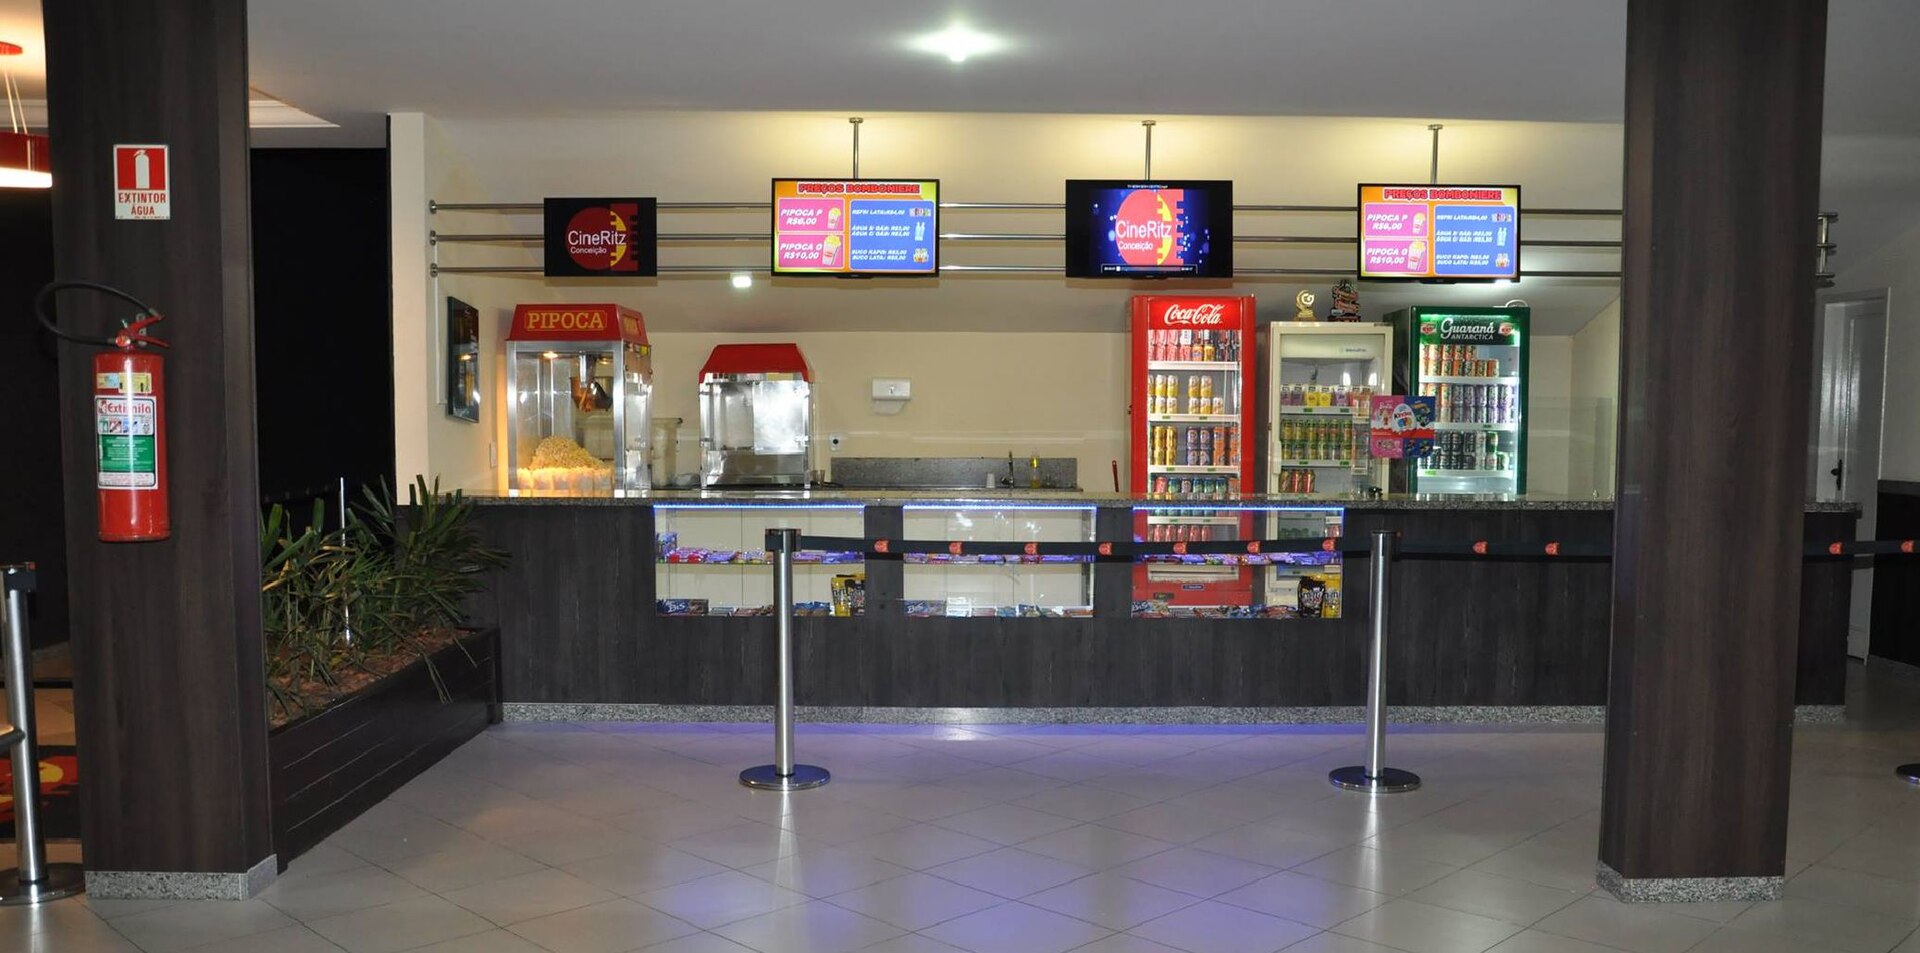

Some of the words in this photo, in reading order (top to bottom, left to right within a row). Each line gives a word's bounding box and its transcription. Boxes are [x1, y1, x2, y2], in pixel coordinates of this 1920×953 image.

[798, 184, 844, 194] PREÇOS
[846, 184, 920, 193] BOMBONIERE
[118, 193, 167, 204] EXTINTOR
[1384, 190, 1428, 200] PREÇOS
[1429, 190, 1501, 200] BOMBONIERE
[131, 204, 155, 215] ÁGUA
[780, 208, 814, 217] PIPOCA
[816, 208, 824, 217] P
[1367, 214, 1400, 222] PIPOCA
[1402, 214, 1409, 222] P
[1116, 221, 1172, 239] CineRitz
[568, 231, 626, 246] CineRitz
[780, 243, 814, 251] PIPOCA
[1118, 240, 1153, 252] Conceição
[571, 247, 608, 256] Conceição
[783, 252, 820, 261] R$10,00
[1367, 248, 1400, 256] PIPOCA
[1370, 257, 1405, 266] R$10,00
[1164, 304, 1226, 325] Coca-Cola
[528, 312, 605, 329] PIPOCA
[1440, 317, 1496, 339] Guaraná
[1451, 333, 1494, 341] ANTARCTICA
